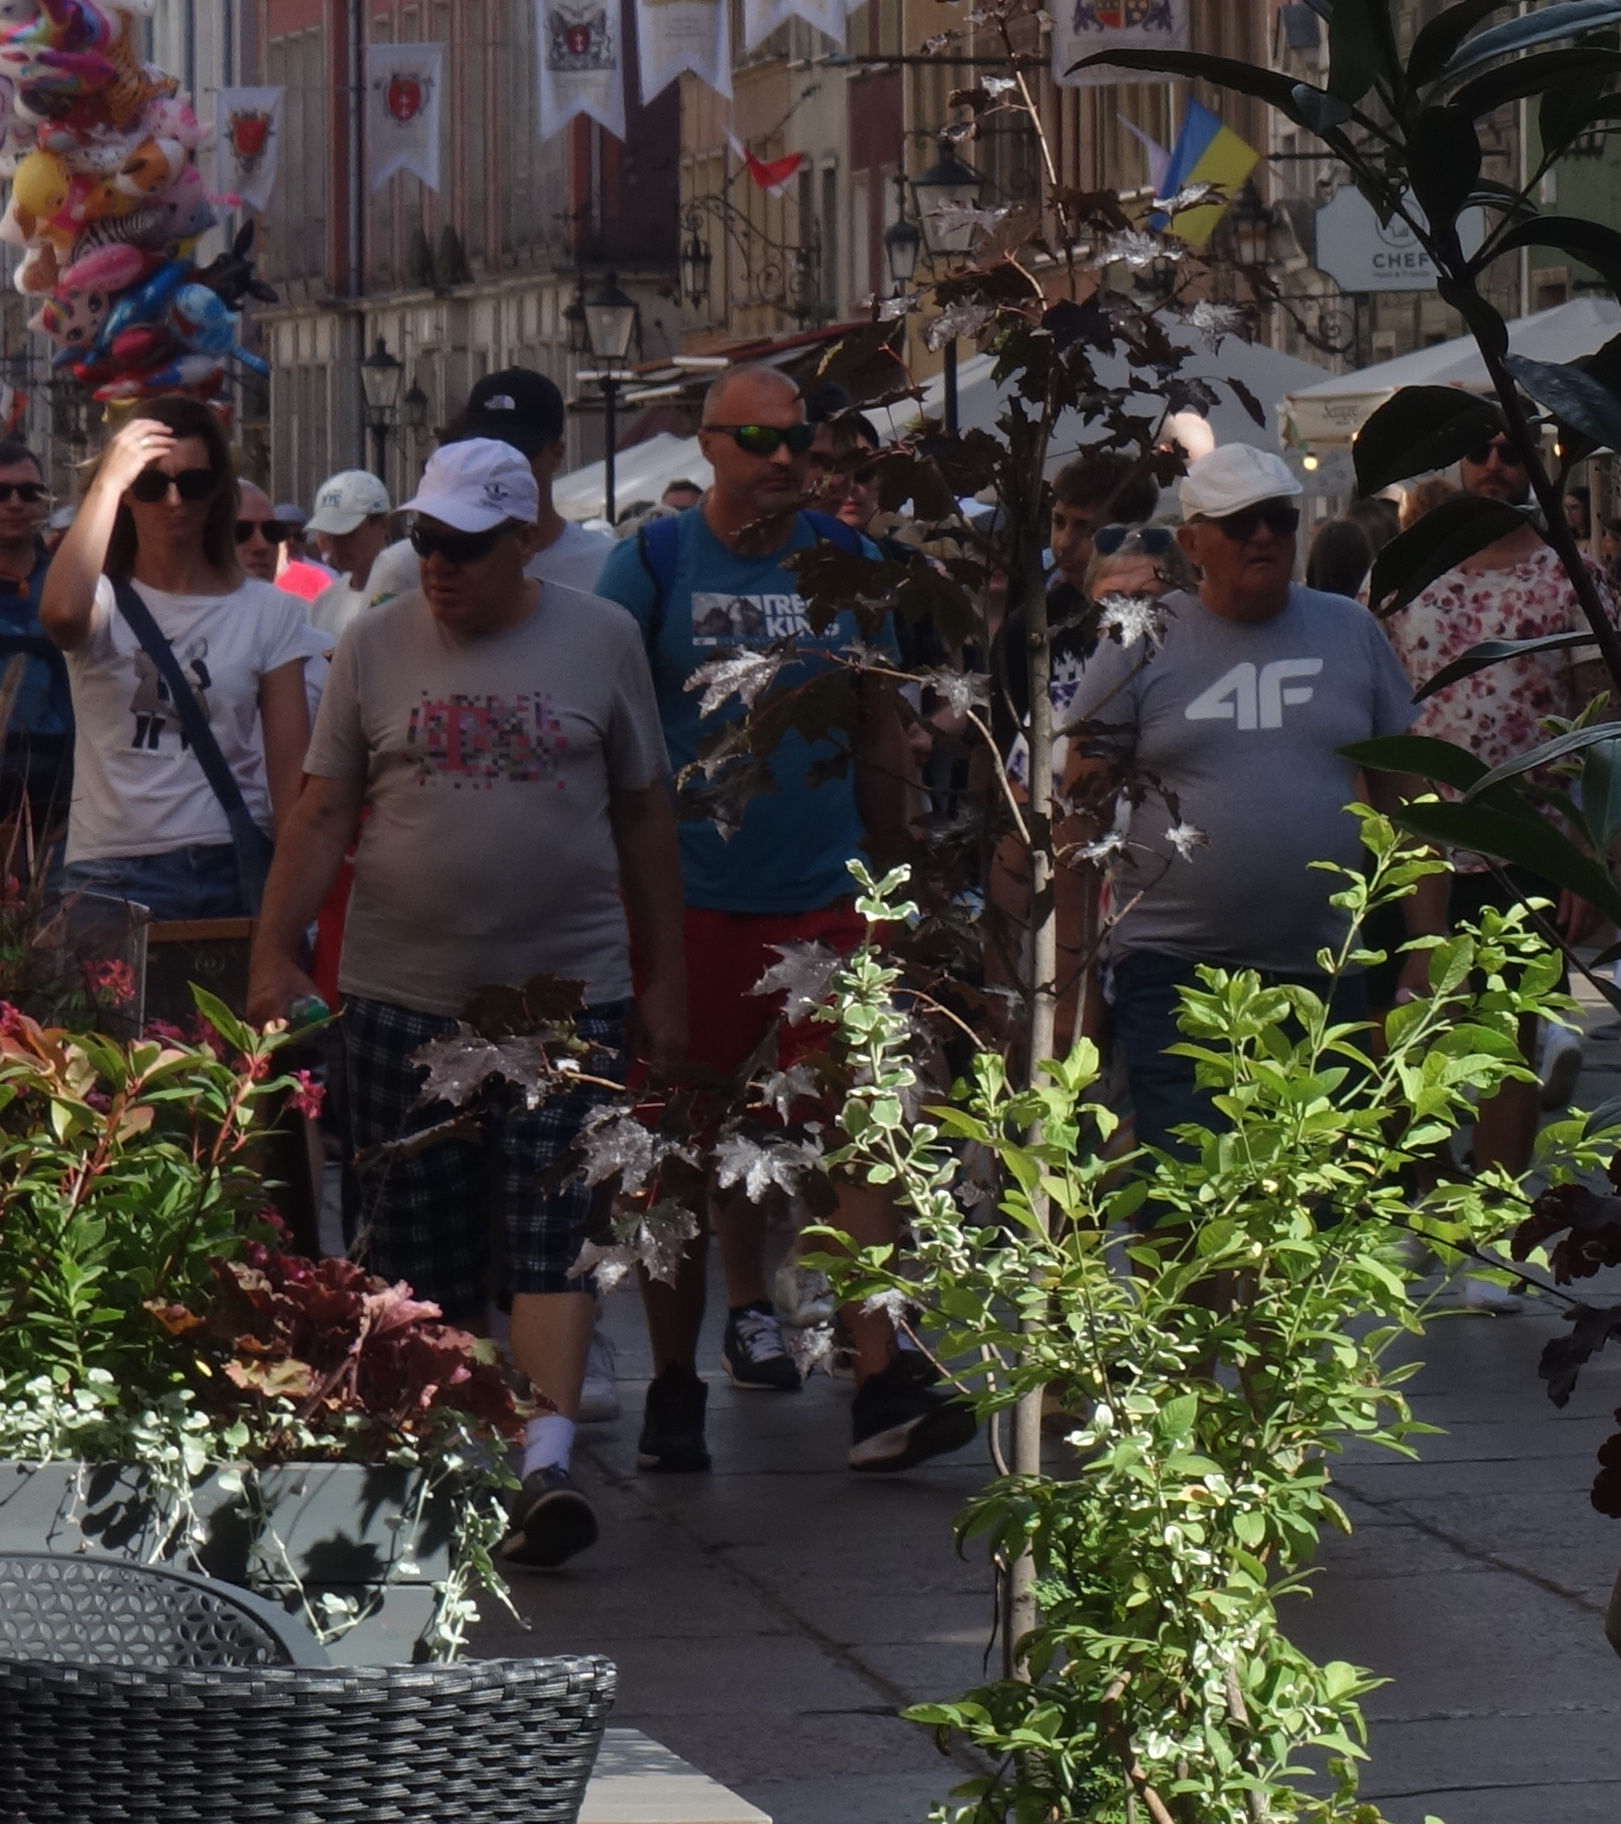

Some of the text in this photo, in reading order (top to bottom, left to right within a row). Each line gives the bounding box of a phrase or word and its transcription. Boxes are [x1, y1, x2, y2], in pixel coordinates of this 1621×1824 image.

[1372, 252, 1430, 269] CHEF
[762, 593, 814, 615] TRE
[1183, 657, 1324, 730] 4F
